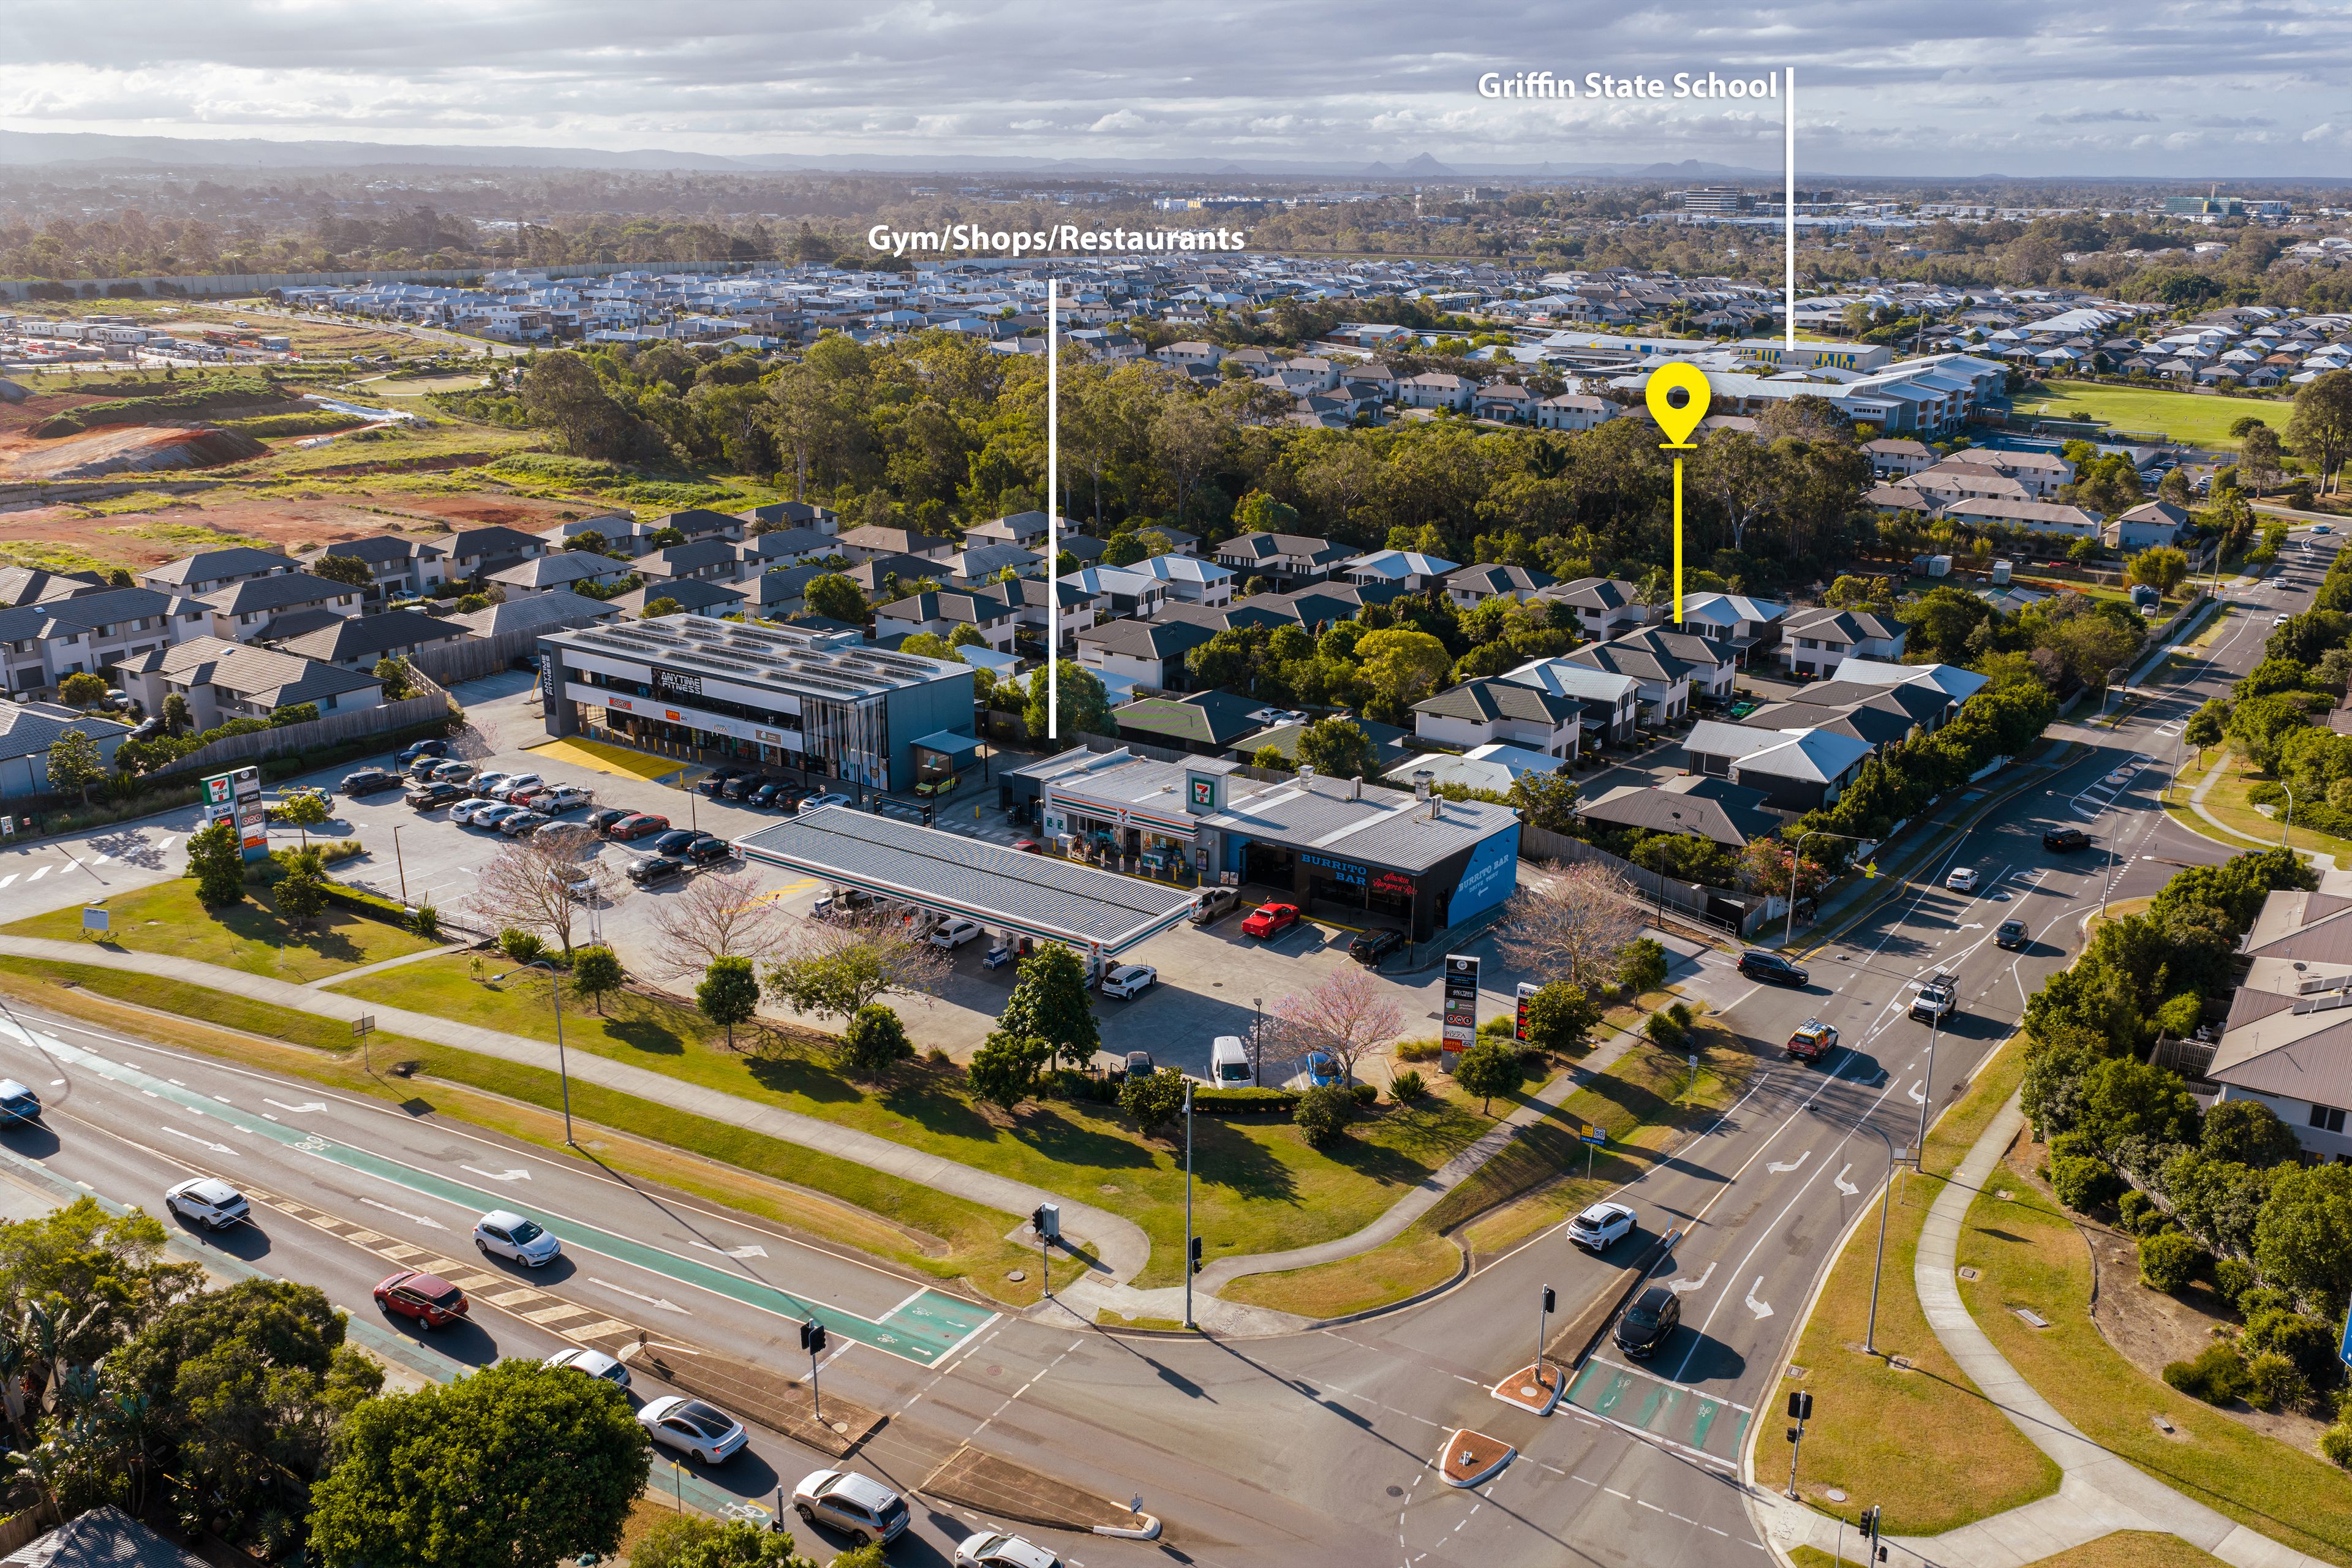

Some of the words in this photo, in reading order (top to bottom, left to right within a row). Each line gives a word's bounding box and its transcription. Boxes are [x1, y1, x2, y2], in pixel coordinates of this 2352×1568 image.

[661, 671, 700, 687] ANYTIME
[662, 680, 701, 695] FITNESS
[713, 725, 728, 733] PIZZA
[212, 780, 226, 801] 7
[1196, 785, 1208, 802] 7
[213, 806, 231, 816] Mobil
[243, 815, 261, 824] BWS
[1302, 854, 1367, 875] BURRITO
[1336, 872, 1366, 886] BAR
[1384, 872, 1409, 884] Smokin
[1458, 865, 1491, 892] BURRITO
[1494, 854, 1509, 870] BAR
[1469, 880, 1483, 893] DRIVE
[1485, 870, 1499, 882] THRU
[1091, 941, 1099, 956] 7
[1448, 1016, 1471, 1024] BWS
